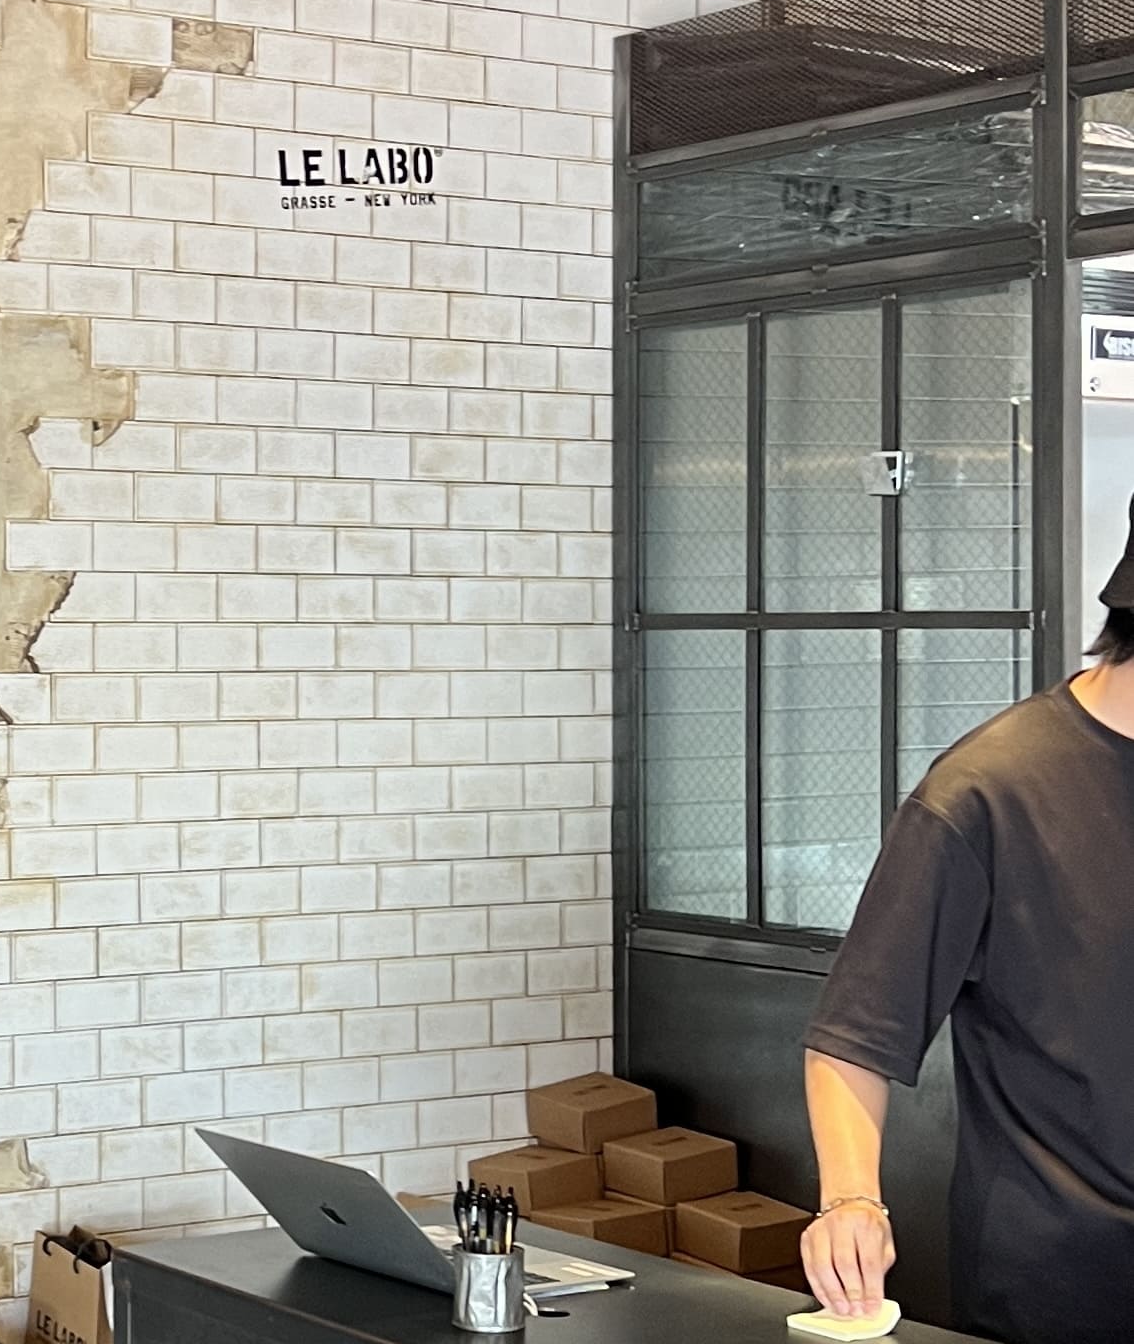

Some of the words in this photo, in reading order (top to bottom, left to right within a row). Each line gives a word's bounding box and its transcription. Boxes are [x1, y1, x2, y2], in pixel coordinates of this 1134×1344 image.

[278, 150, 325, 186] LE
[281, 195, 336, 210] GRASSE
[365, 194, 391, 206] NEW
[401, 192, 436, 206] YORK
[36, 1309, 51, 1335] LE
